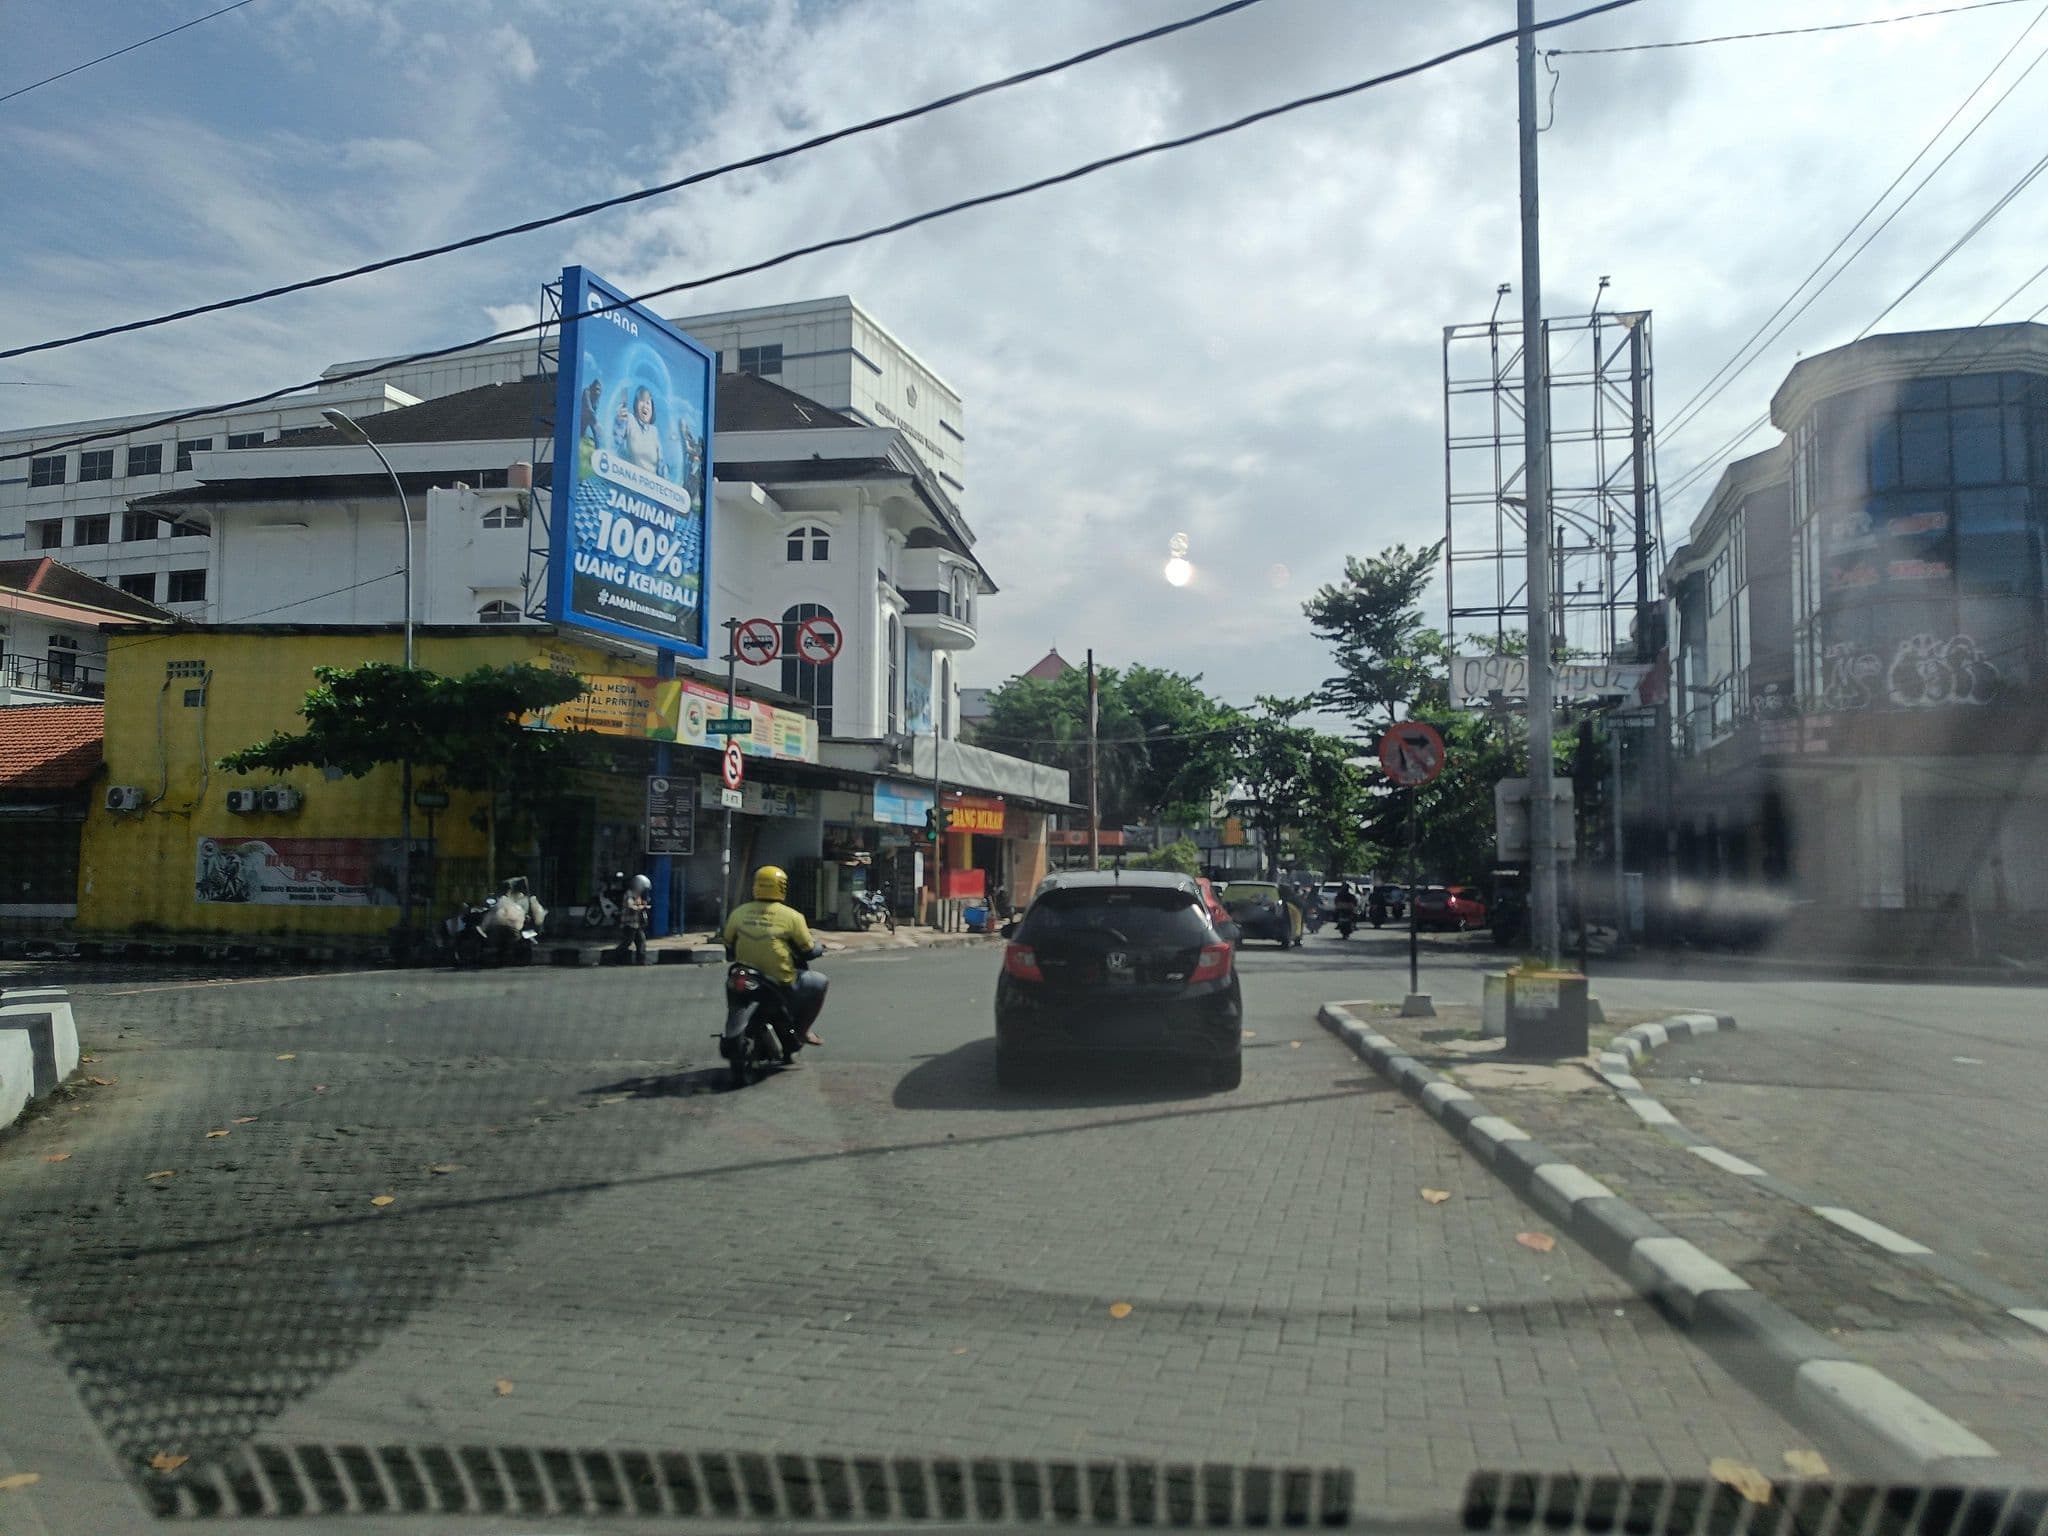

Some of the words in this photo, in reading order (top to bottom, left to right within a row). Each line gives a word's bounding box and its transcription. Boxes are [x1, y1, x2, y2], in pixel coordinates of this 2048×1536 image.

[612, 463, 638, 486] DANA
[639, 473, 687, 503] PROTECTION
[607, 488, 677, 532] JAMINAN
[596, 509, 684, 578] 100%
[574, 552, 626, 585] UANG
[627, 570, 698, 608] KEMBALI
[605, 697, 651, 709] PRINTING
[607, 684, 638, 695] MEDIA
